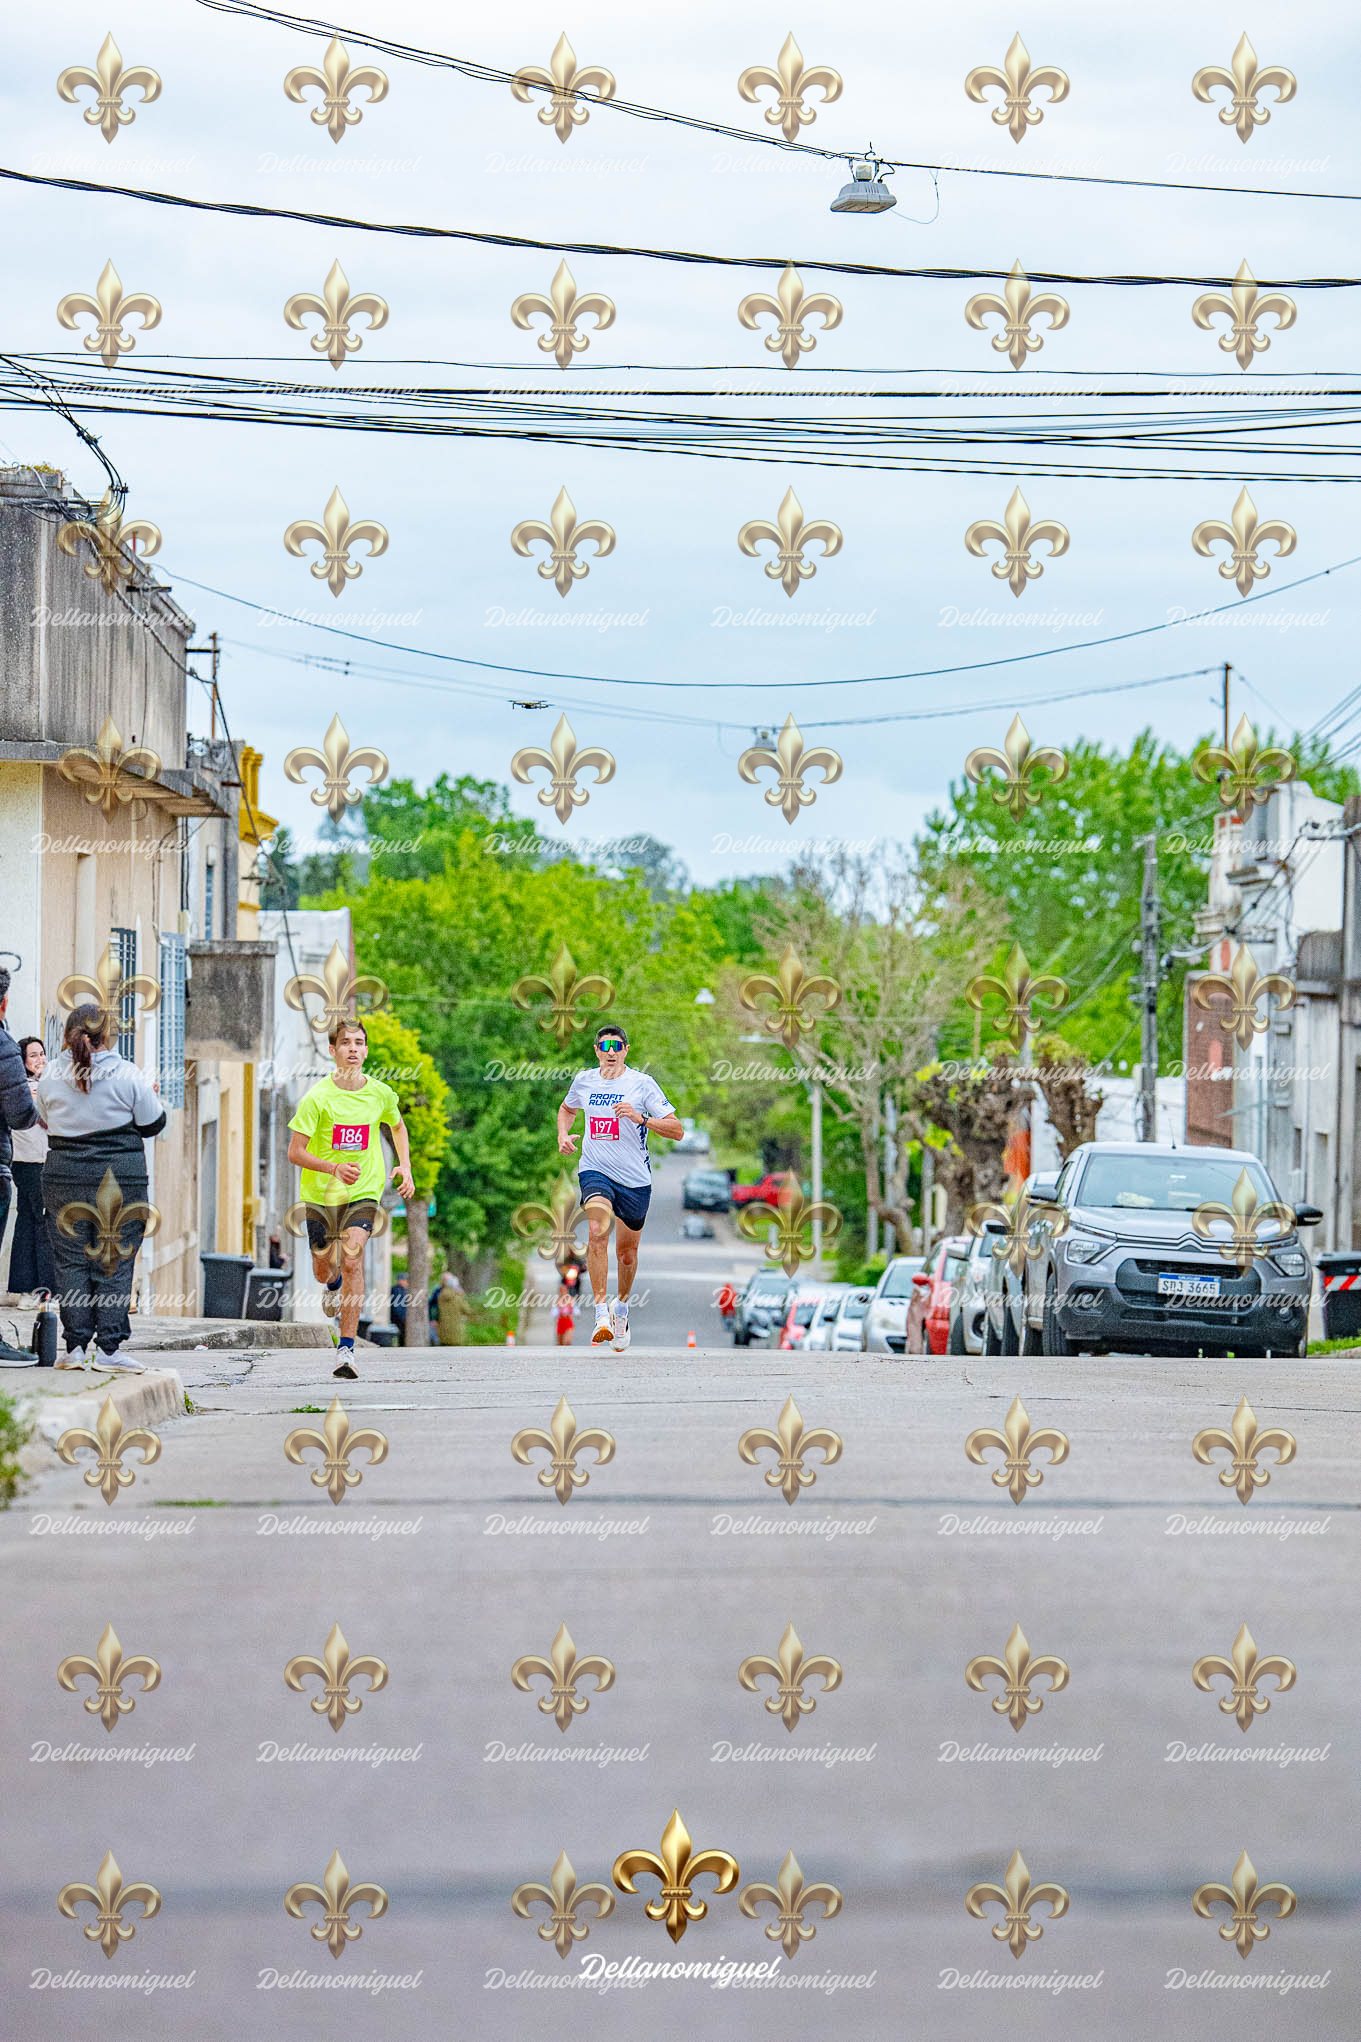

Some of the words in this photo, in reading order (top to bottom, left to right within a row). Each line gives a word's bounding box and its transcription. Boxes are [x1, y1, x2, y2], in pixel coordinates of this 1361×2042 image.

[594, 1121, 612, 1133] 197
[340, 1128, 363, 1143] 186
[1188, 1282, 1216, 1295] 3665
